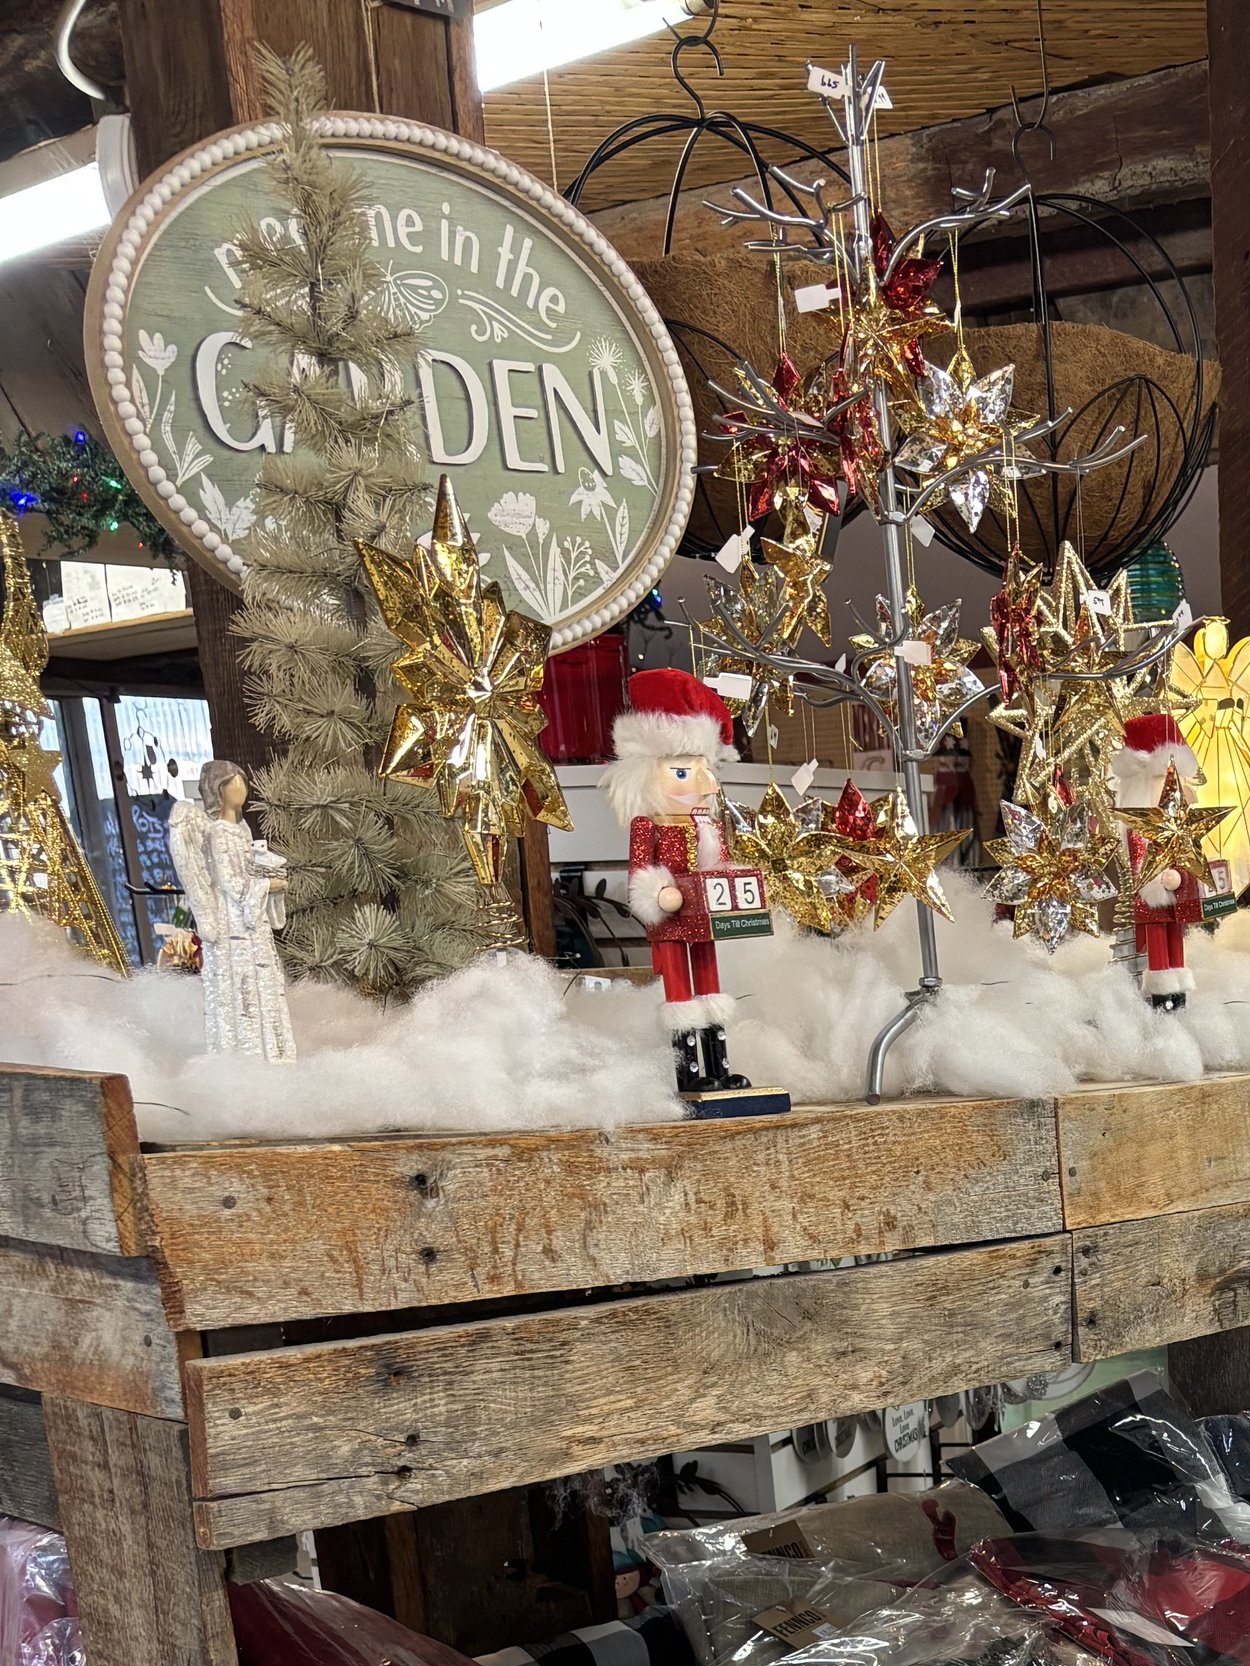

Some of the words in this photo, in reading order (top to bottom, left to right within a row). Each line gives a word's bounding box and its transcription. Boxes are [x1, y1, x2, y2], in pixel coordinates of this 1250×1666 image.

[441, 202, 480, 273] in
[496, 224, 566, 328] the
[715, 920, 731, 931] Days
[731, 920, 740, 928] Till
[741, 918, 770, 928] Christmas
[772, 1610, 822, 1638] FENNCO
